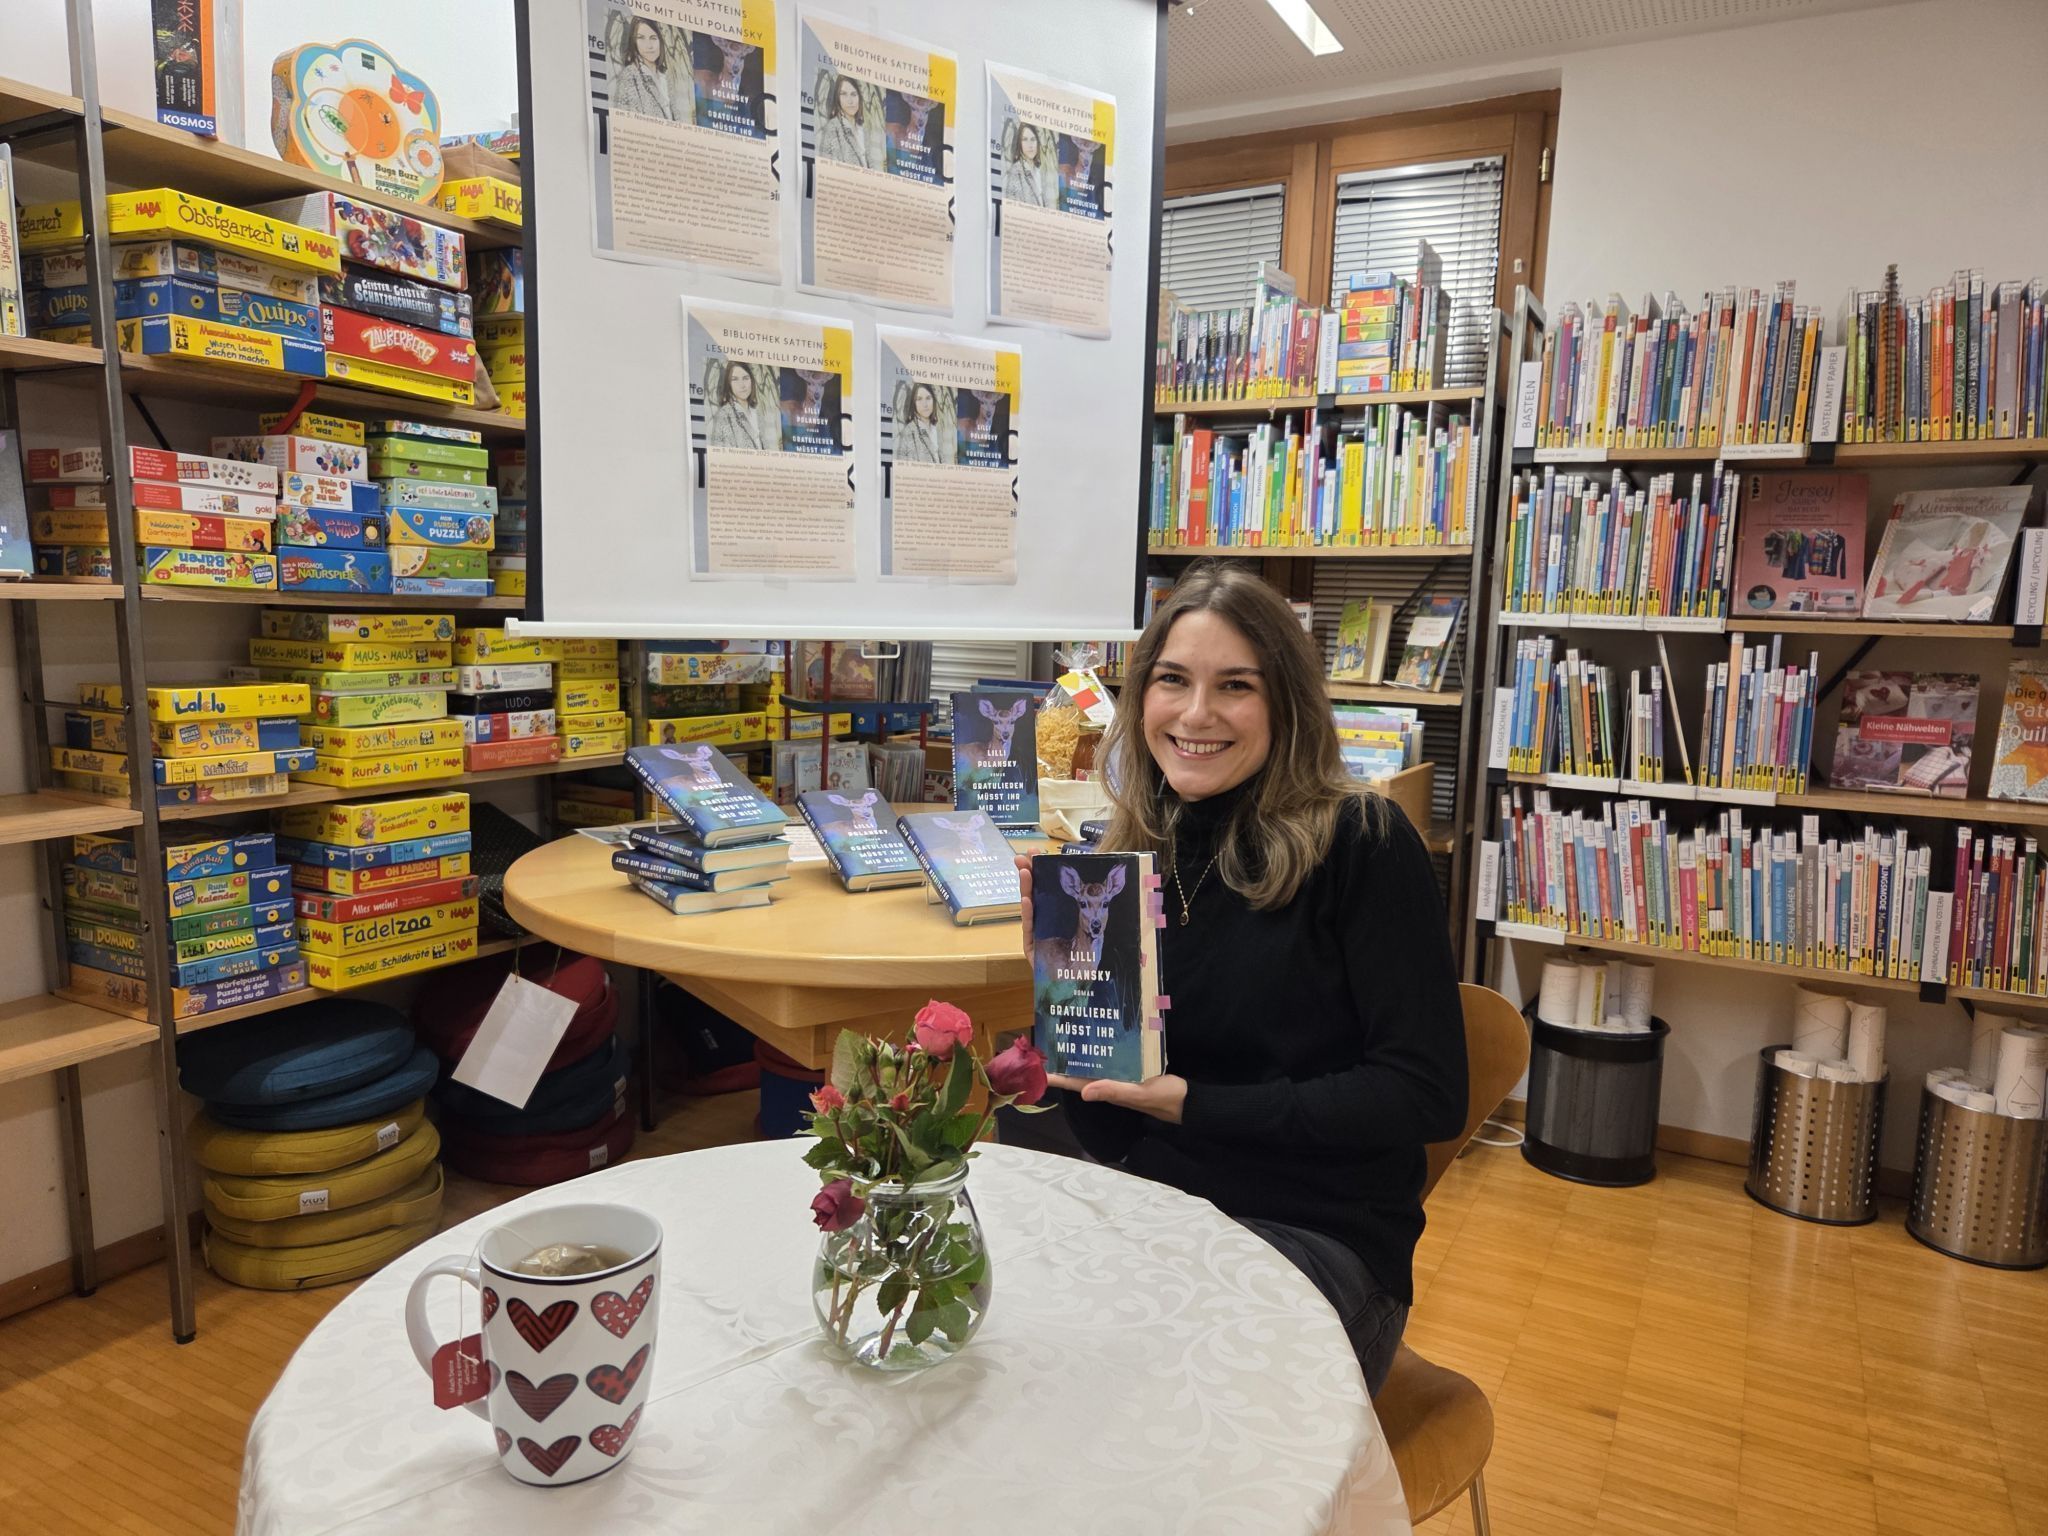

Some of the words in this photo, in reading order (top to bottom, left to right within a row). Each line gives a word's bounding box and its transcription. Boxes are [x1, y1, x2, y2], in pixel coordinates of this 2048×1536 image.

[696, 0, 748, 19] SATTEINS
[655, 8, 673, 19] MIT
[678, 13, 704, 26] LILLI
[708, 19, 763, 41] POLANSKY
[834, 41, 888, 64] BIBLIOTHEK
[891, 59, 933, 78] SATTEINS
[818, 54, 853, 72] LESUNG
[856, 67, 872, 79] MIT
[874, 72, 896, 84] LILLI
[899, 78, 946, 97] POLANSKY
[1017, 92, 1061, 111] BIBLIOTHEK
[1063, 105, 1097, 121] SATTEINS
[163, 113, 215, 131] KOSMOS
[1004, 104, 1033, 119] LESUNG
[1035, 114, 1048, 123] MIT
[1050, 118, 1067, 129] LILLI
[1069, 123, 1107, 139] POLANSKY
[375, 163, 397, 176] Bugs
[398, 170, 419, 182] Buzz
[460, 185, 484, 200] HABA
[135, 201, 162, 219] HABA
[178, 203, 275, 246] Obstgarten
[305, 239, 335, 260] HABA
[172, 278, 216, 295] Ravensburger
[50, 290, 88, 318] Quips
[249, 301, 307, 329] Quips
[209, 339, 237, 351] Wissen,
[283, 338, 324, 353] Ravensburger
[363, 327, 437, 363] ZAUBERBERG
[723, 329, 780, 344] BIBLIOTHEK
[783, 338, 829, 350] SATTEINS
[204, 348, 237, 360] Sachen
[238, 353, 270, 366] machen
[706, 343, 744, 357] LESUNG
[747, 350, 765, 359] MIT
[767, 352, 790, 363] LILLI
[793, 355, 841, 368] POLANSKY
[911, 353, 960, 368] BIBLIOTHEK
[962, 360, 1000, 372] SATTEINS
[1826, 351, 1838, 381] PAPIER
[896, 367, 928, 379] LESUNG
[930, 372, 945, 380] MIT
[947, 374, 967, 384] LILLI
[969, 377, 1012, 389] POLANSKY
[1823, 383, 1834, 399] MIT
[1521, 380, 1536, 429] BASTELN
[308, 416, 322, 426] Ich
[324, 418, 344, 429] sehe
[1821, 400, 1833, 437] BASTELN
[316, 426, 332, 436] was
[300, 443, 316, 453] goki
[257, 480, 275, 490] goki
[318, 486, 337, 495] Tier
[255, 505, 272, 515] goki
[429, 527, 466, 539] PUZZLE
[178, 552, 225, 568] Bären
[2031, 530, 2044, 574] UPCYCLING
[297, 561, 324, 570] KOSMOS
[298, 566, 358, 581] NATURSPIELE
[2027, 580, 2039, 624] RECYCLING
[353, 651, 380, 662] MAUS
[390, 649, 413, 661] HAUS
[2015, 686, 2035, 700] Die
[173, 691, 226, 714] Lalelu
[505, 696, 531, 709] LUDO
[1495, 699, 1508, 758] GELDGESCHENKE
[1866, 721, 1894, 732] Kleine
[1896, 722, 1946, 735] Nähwelten
[213, 735, 241, 747] Uhr?
[276, 751, 314, 761] Ravensburger
[977, 760, 1017, 768] POLANSKY
[352, 763, 381, 778] Rund
[383, 763, 391, 774] &
[972, 782, 1024, 790] GRATULIEREN
[977, 792, 1004, 800] MÜSST
[442, 800, 465, 814] HABA
[979, 804, 994, 812] MIR
[329, 812, 348, 826] HABA
[1618, 811, 1629, 841] Einfach
[234, 837, 273, 847] Ravensburger
[180, 856, 204, 876] Blinde
[386, 867, 397, 877] OH
[398, 860, 438, 874] PARDON
[251, 869, 289, 880] Ravensburger
[1484, 854, 1493, 907] HANDARBEITEN
[1622, 865, 1631, 896] NÄHEN
[207, 882, 229, 892] Rund
[197, 891, 239, 905] Kalender
[1786, 886, 1796, 914] NÄHEN
[255, 902, 291, 913] Ravensburger
[351, 905, 370, 916] Alles
[373, 898, 399, 911] meins!
[451, 906, 475, 919] HABA
[1936, 896, 1945, 919] OSTERN
[257, 922, 294, 934] Ravensburger
[96, 931, 136, 950] DOMINO
[206, 934, 255, 953] DOMINO
[312, 929, 334, 944] HABA
[261, 945, 297, 956] Ravensburger
[381, 949, 430, 968] Schildkröte
[1070, 951, 1096, 963] LILLI
[1931, 934, 1942, 979] WEIHNACHTEN
[219, 960, 255, 974] WUNDER
[233, 963, 258, 975] BAUM
[311, 963, 332, 979] HABA
[216, 974, 267, 991] Würfelpuzzle
[1057, 970, 1111, 982] POLANSKY
[216, 987, 243, 998] Puzzle
[244, 985, 251, 993] di
[253, 981, 270, 991] dadi
[217, 995, 243, 1006] Puzzle
[255, 989, 265, 998] dé
[1050, 1004, 1120, 1020] GRATULIEREN
[1056, 1023, 1091, 1037] MÜSST
[1096, 1026, 1115, 1038] IHR
[1057, 1042, 1076, 1055] MIR
[1082, 1044, 1114, 1058] NICHT
